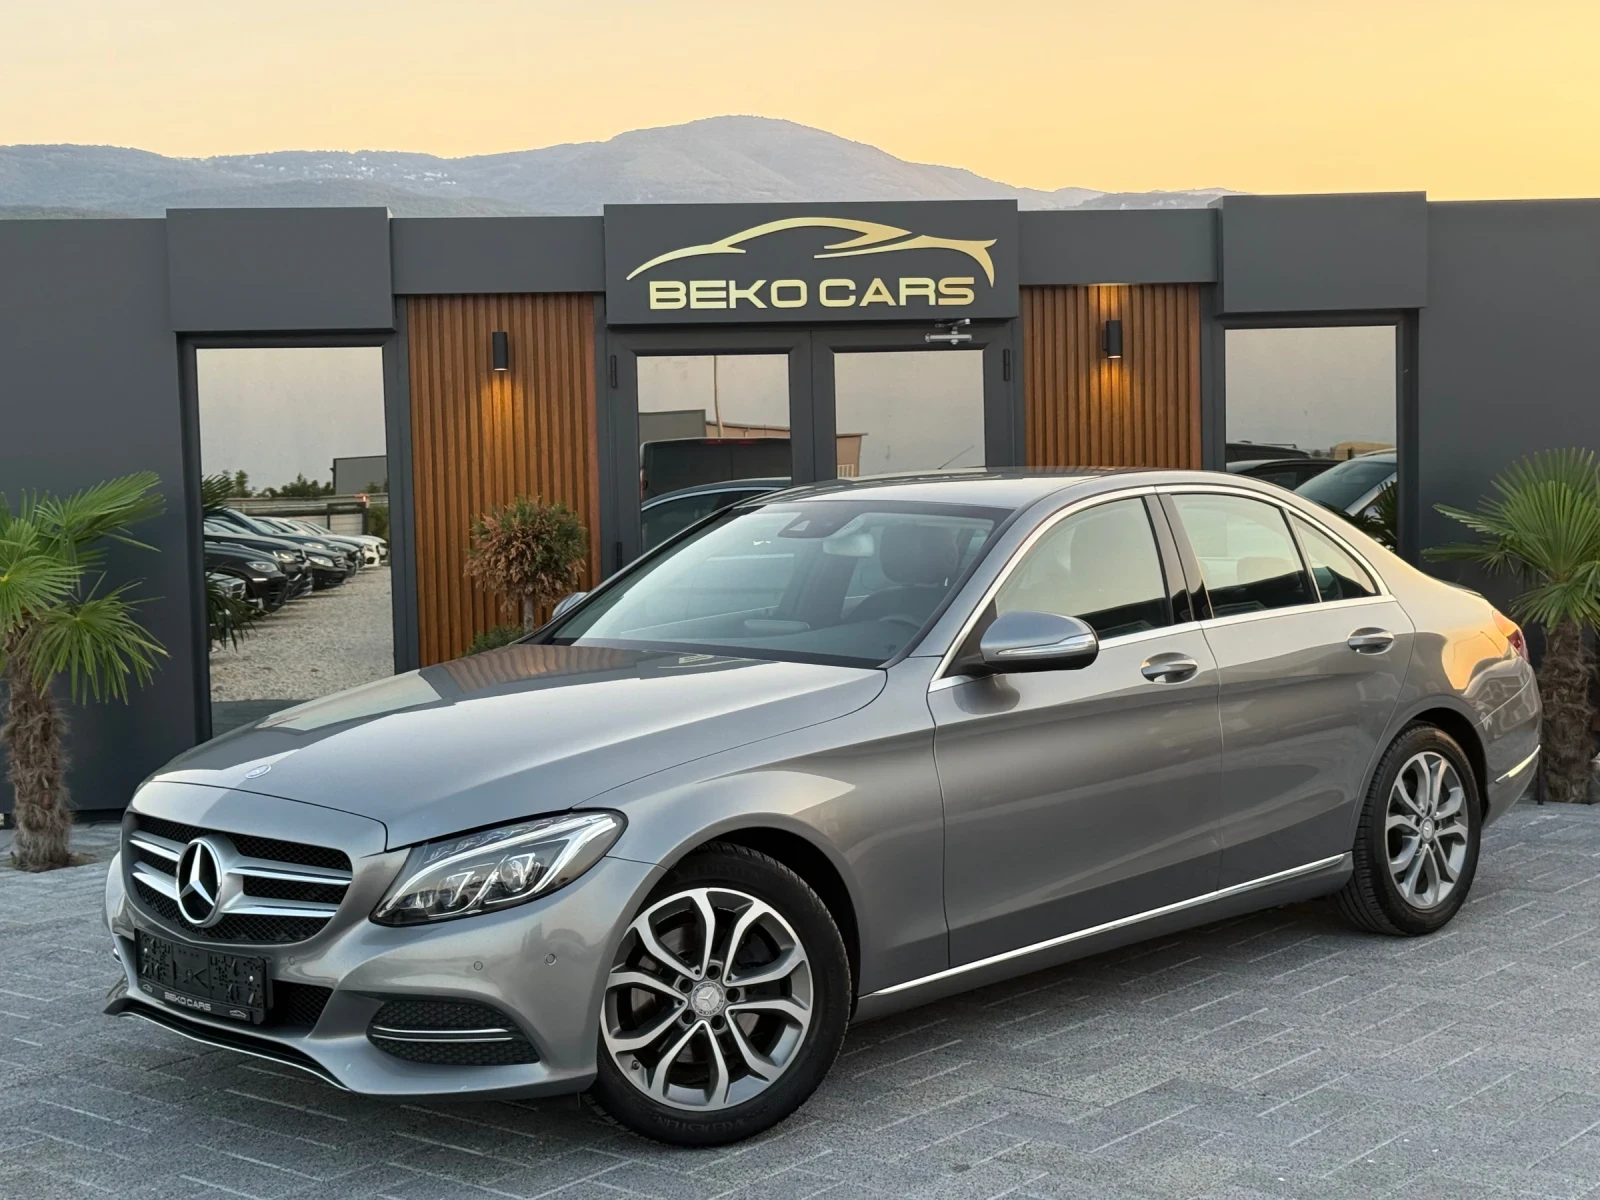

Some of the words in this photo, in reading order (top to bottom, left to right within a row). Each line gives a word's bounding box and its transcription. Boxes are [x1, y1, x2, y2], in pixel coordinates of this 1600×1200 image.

[649, 279, 807, 310] BEKO
[818, 277, 975, 307] CARS
[164, 991, 187, 1005] BEKO
[187, 998, 212, 1011] CARS
